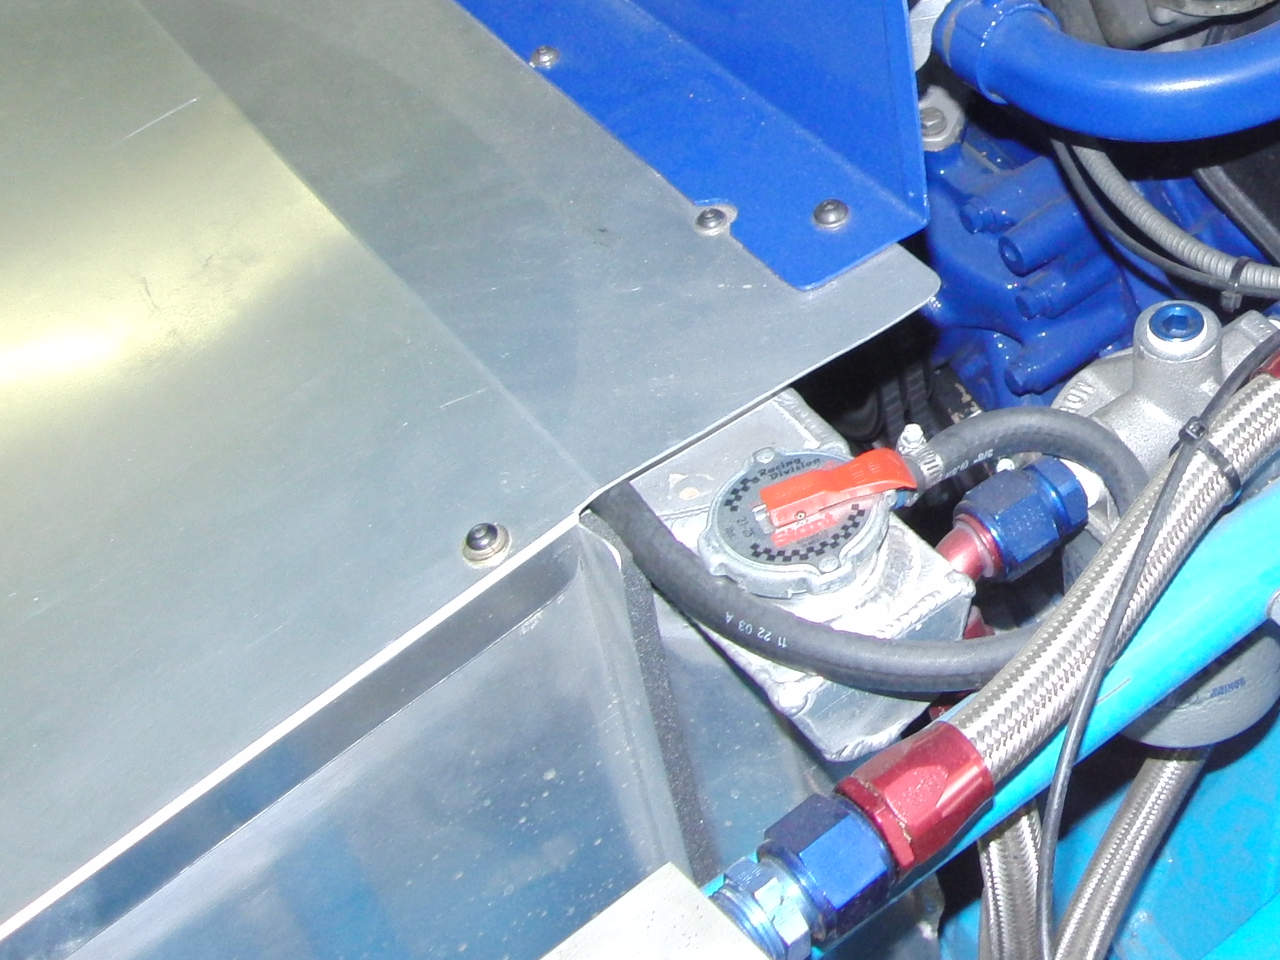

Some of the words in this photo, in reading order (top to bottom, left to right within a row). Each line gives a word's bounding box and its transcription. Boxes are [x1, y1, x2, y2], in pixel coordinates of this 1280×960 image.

[757, 457, 801, 477] Racing
[769, 457, 820, 480] Division
[725, 611, 735, 624] A
[738, 619, 753, 635] 03
[757, 626, 772, 642] 22
[777, 636, 788, 648] 11
